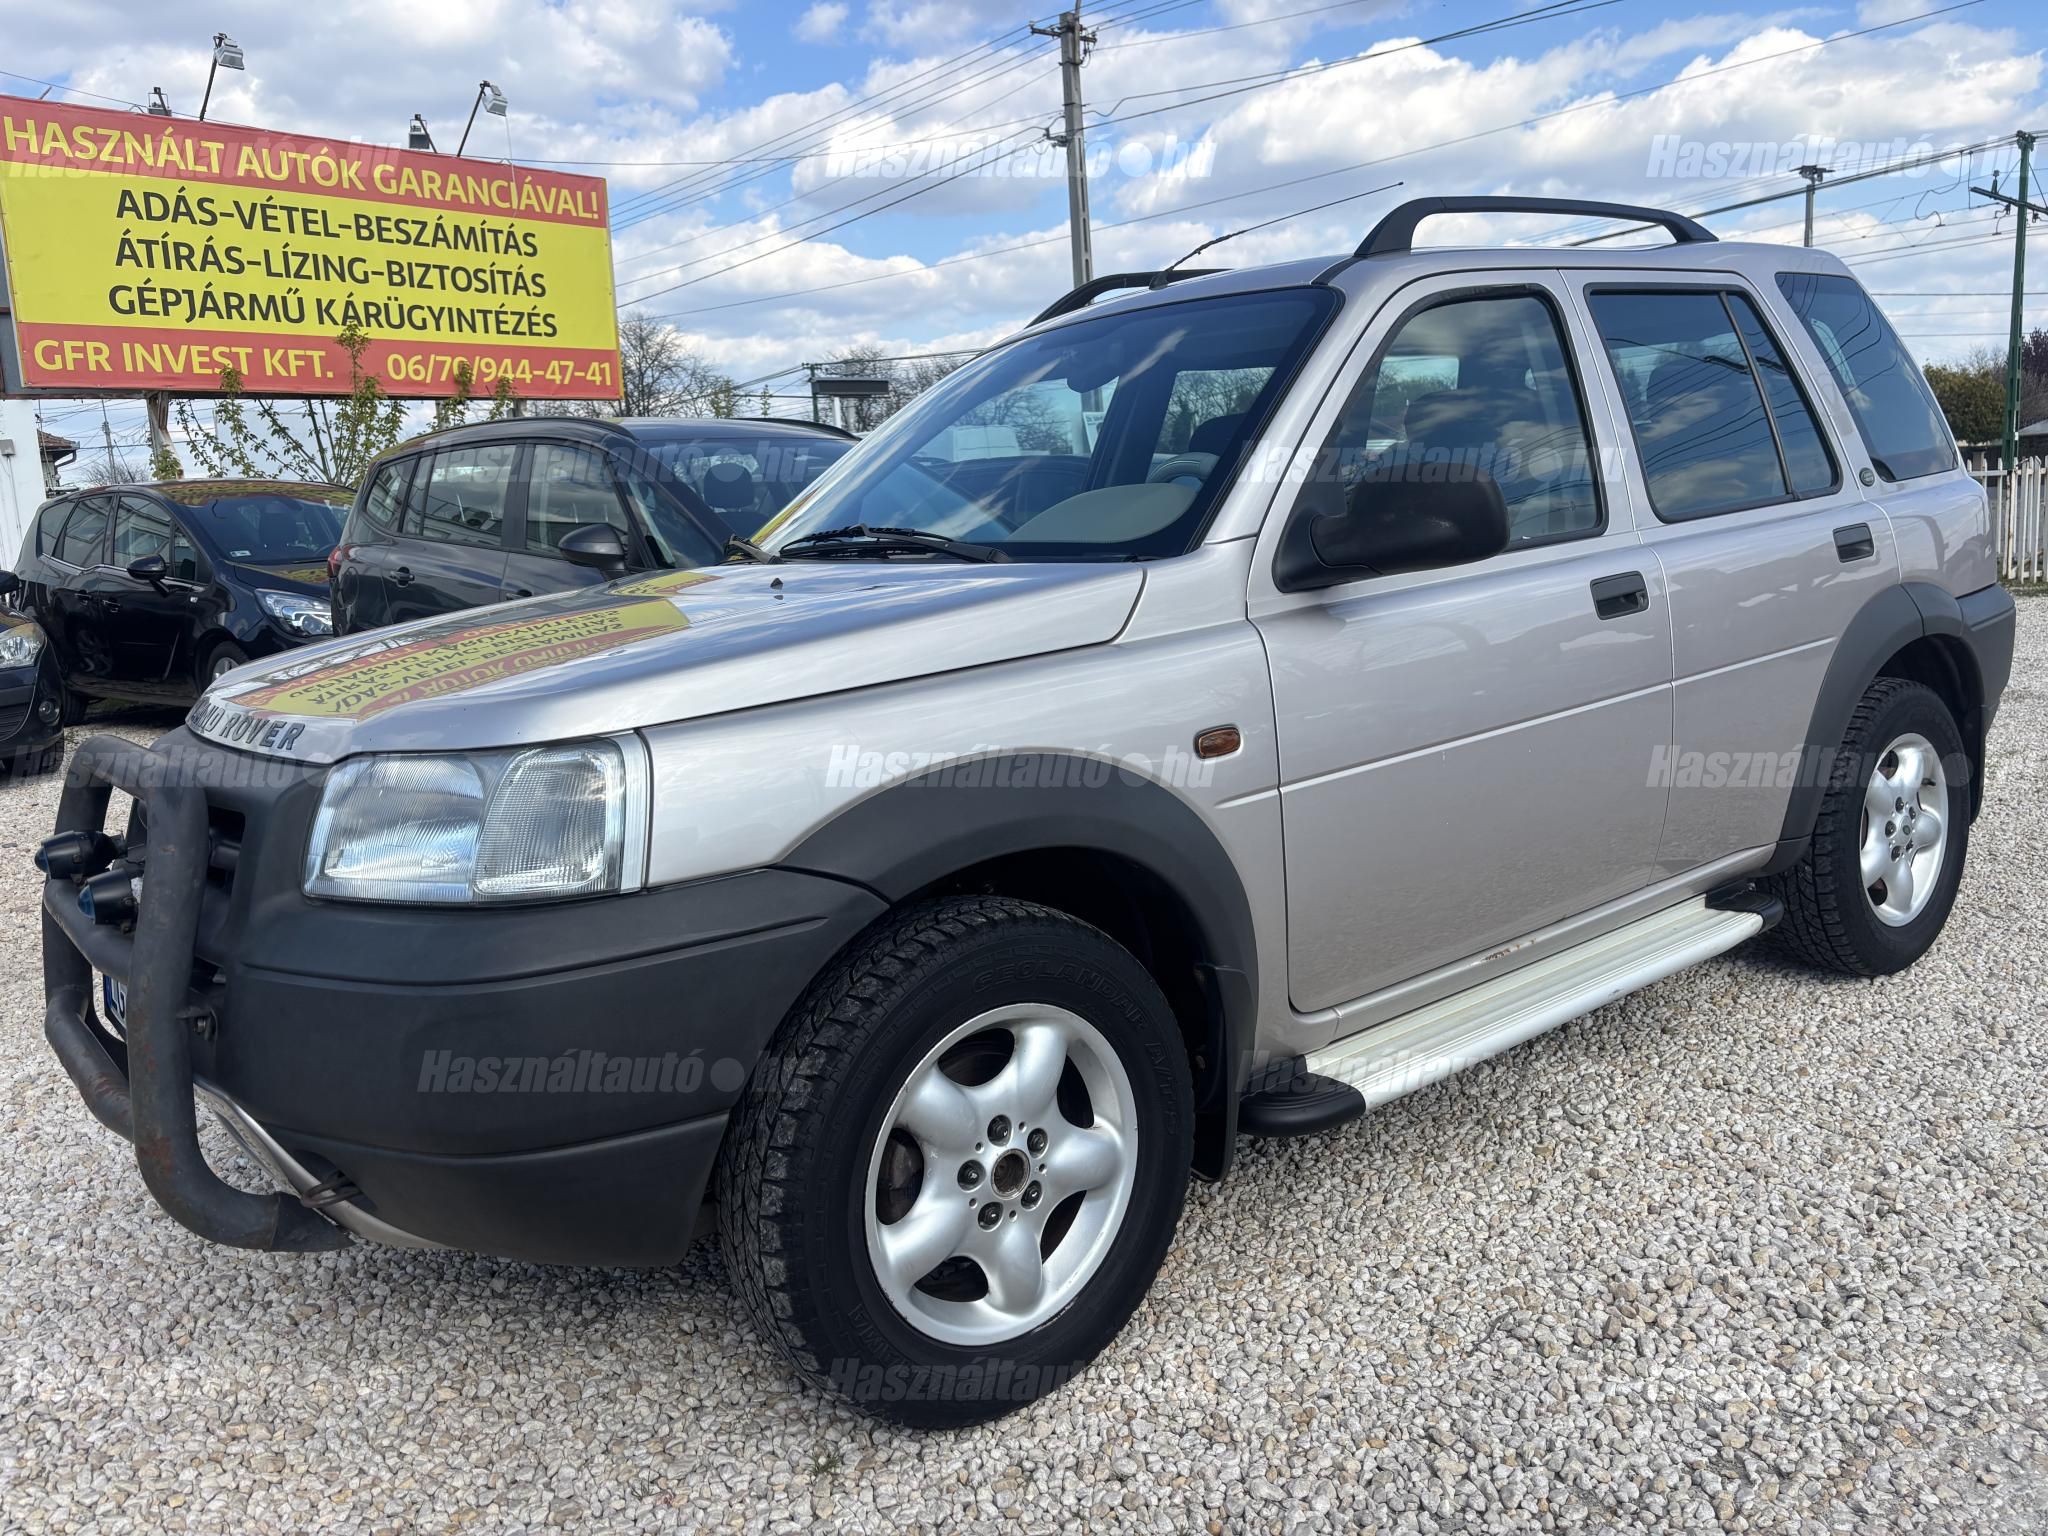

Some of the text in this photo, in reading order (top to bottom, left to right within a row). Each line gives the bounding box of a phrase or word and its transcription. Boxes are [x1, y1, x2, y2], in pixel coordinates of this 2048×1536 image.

[3, 114, 600, 221] HASZNÁLT AUTÓK GARANCIÁVAL!
[116, 186, 540, 258] ADÁS-VÉTEL-BESZÁMÍTÁS
[114, 228, 547, 298] ÁTÍRÁS-LÍZING-BIZTOSÍTÁS
[109, 278, 559, 338] GÉPJÁRMŰ KÁRÜGYINTÉZÉS
[34, 339, 112, 372] GFR
[121, 344, 254, 377] INVEST
[263, 348, 334, 379] KFT.
[219, 712, 306, 751] ROVER
